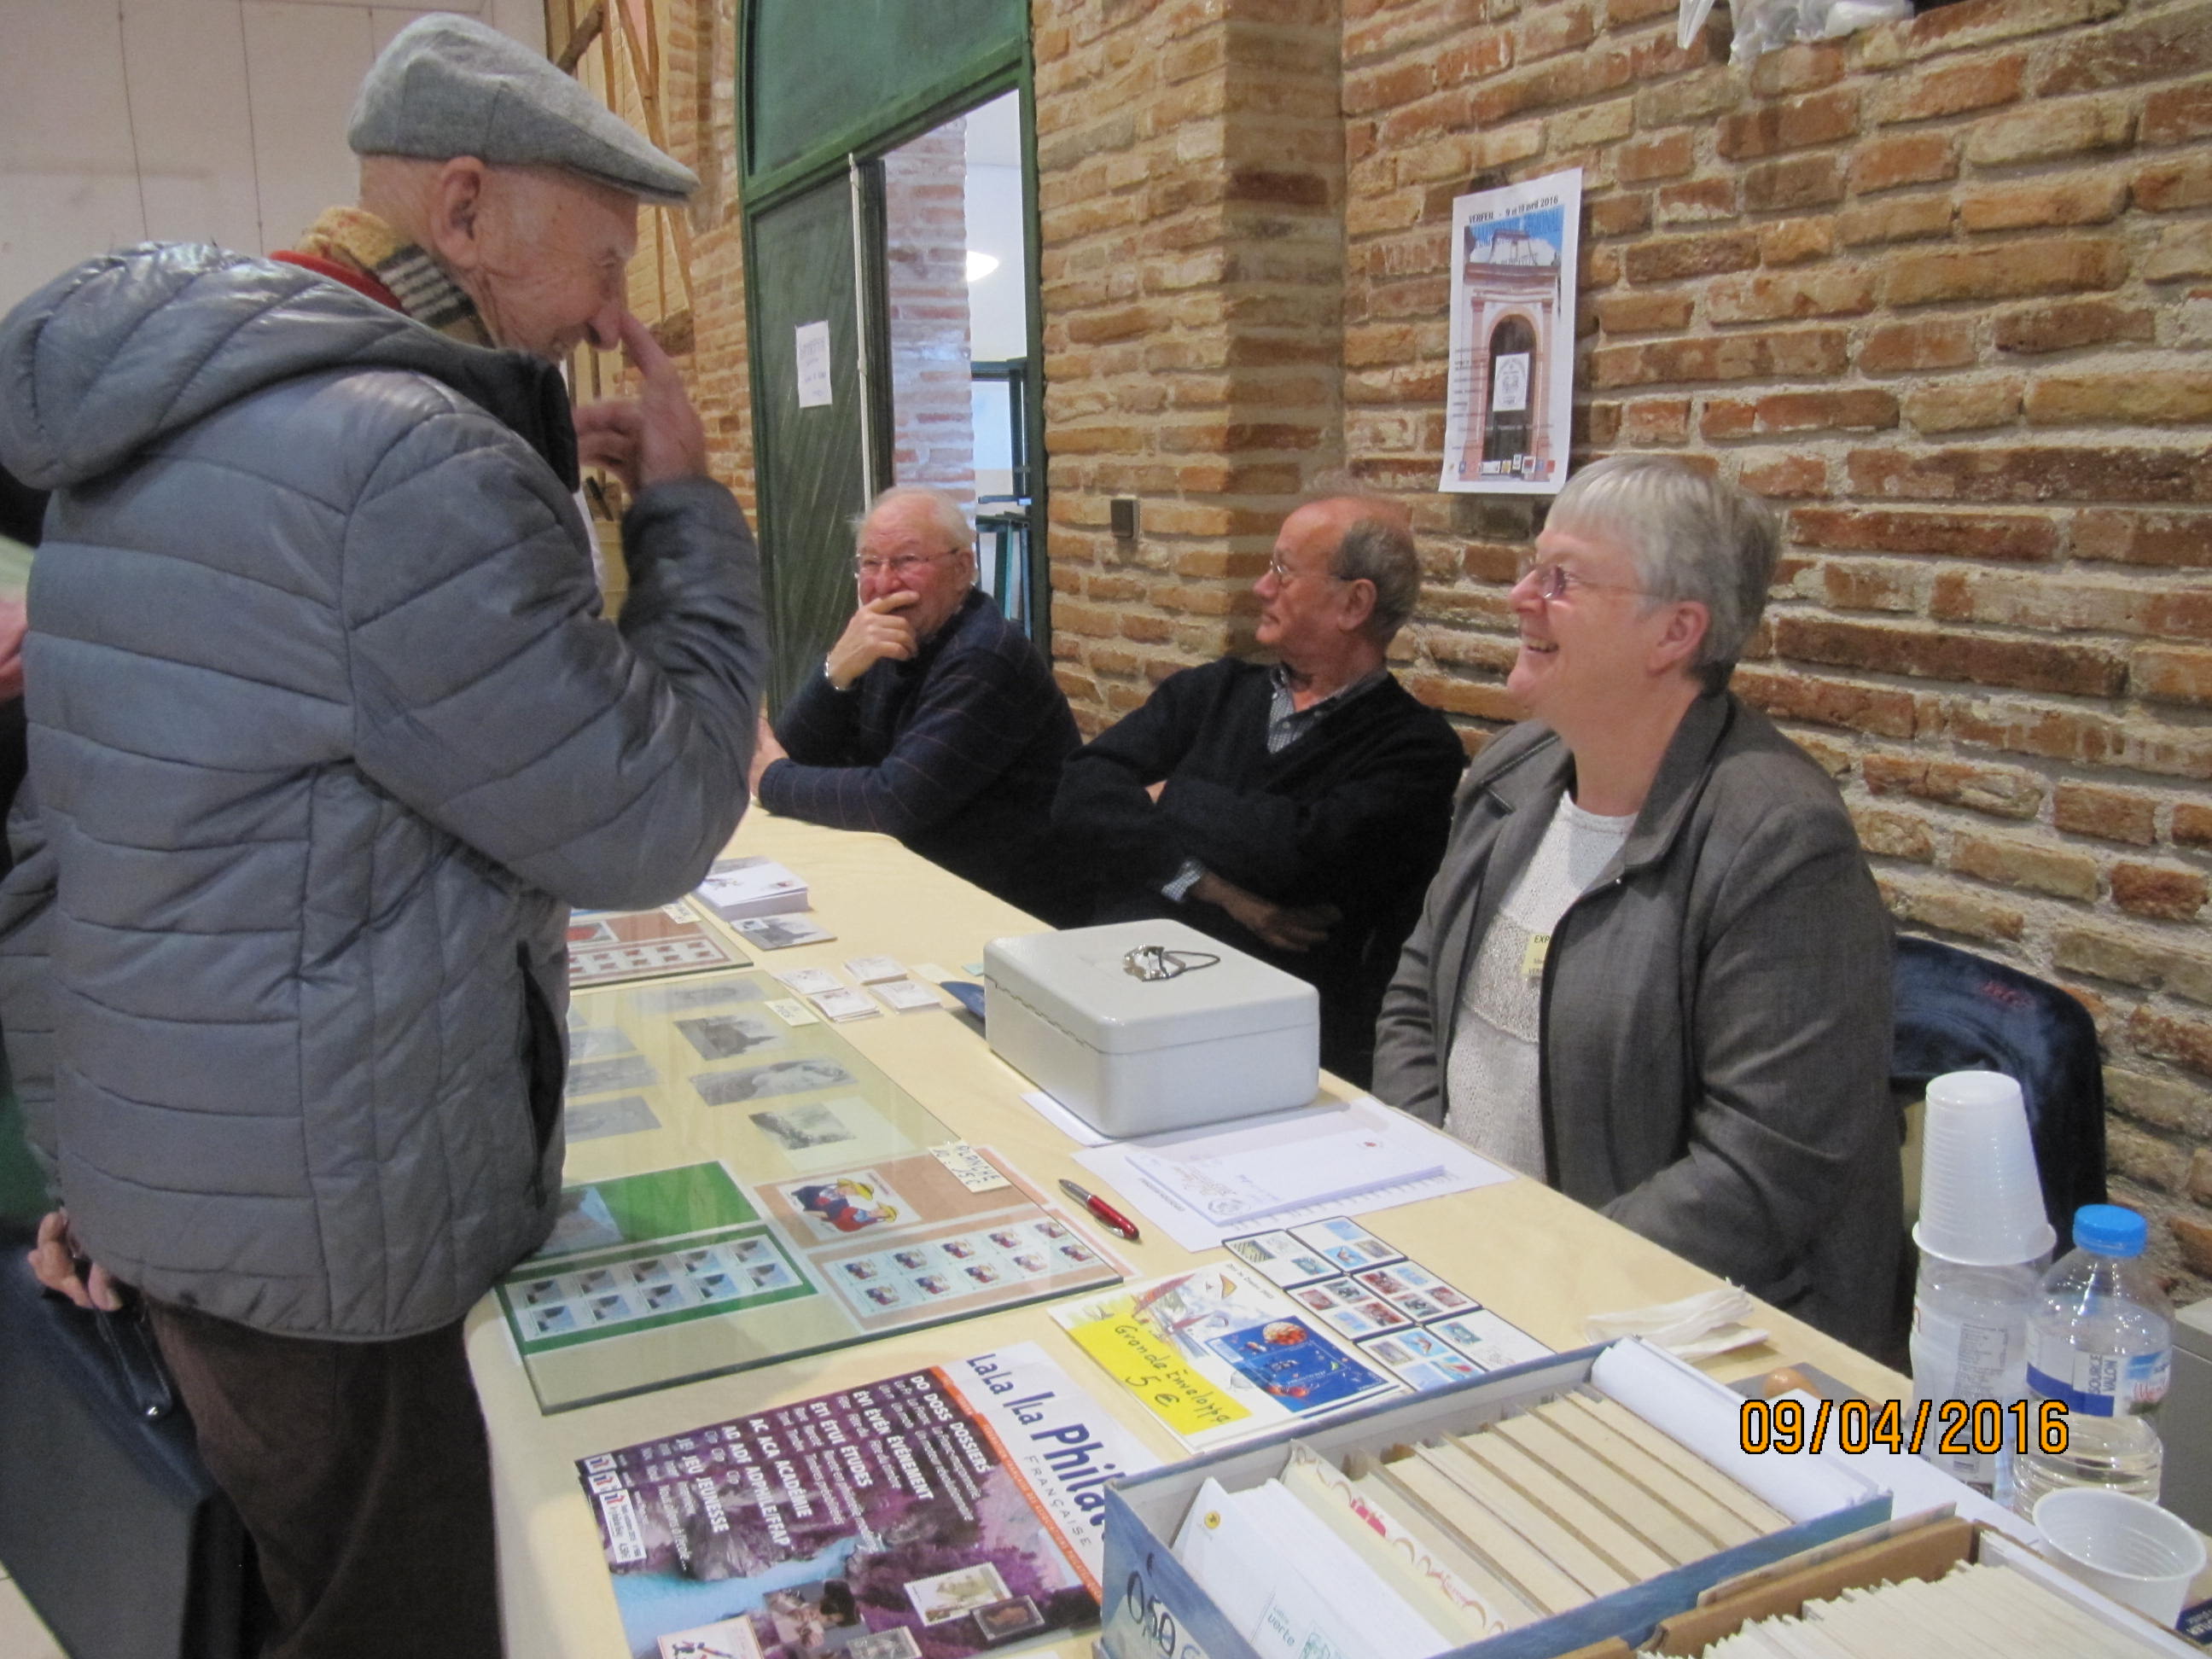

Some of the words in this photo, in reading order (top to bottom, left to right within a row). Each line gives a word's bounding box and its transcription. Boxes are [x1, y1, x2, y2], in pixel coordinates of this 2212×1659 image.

[1540, 195, 1559, 208] 2016
[1534, 934, 1551, 943] EXP
[966, 1353, 998, 1376] La
[2087, 1354, 2103, 1394] SOURCE
[911, 1376, 930, 1391] DO
[982, 1371, 1014, 1394] La
[1125, 1376, 1161, 1387] 5
[1154, 1394, 1180, 1407] €
[923, 1393, 953, 1423] DOSS
[1011, 1402, 1044, 1425] La
[757, 1436, 781, 1459] ACA
[949, 1422, 995, 1475] DOSSIERS
[683, 1454, 704, 1475] JEU
[841, 1445, 874, 1488] ÉTUDES
[888, 1435, 934, 1500] ÉVÉNEMENT
[774, 1460, 813, 1518] ACADÉMIE
[1025, 1454, 1091, 1548] FRANÇAISE
[696, 1476, 731, 1534] JEUNESSE
